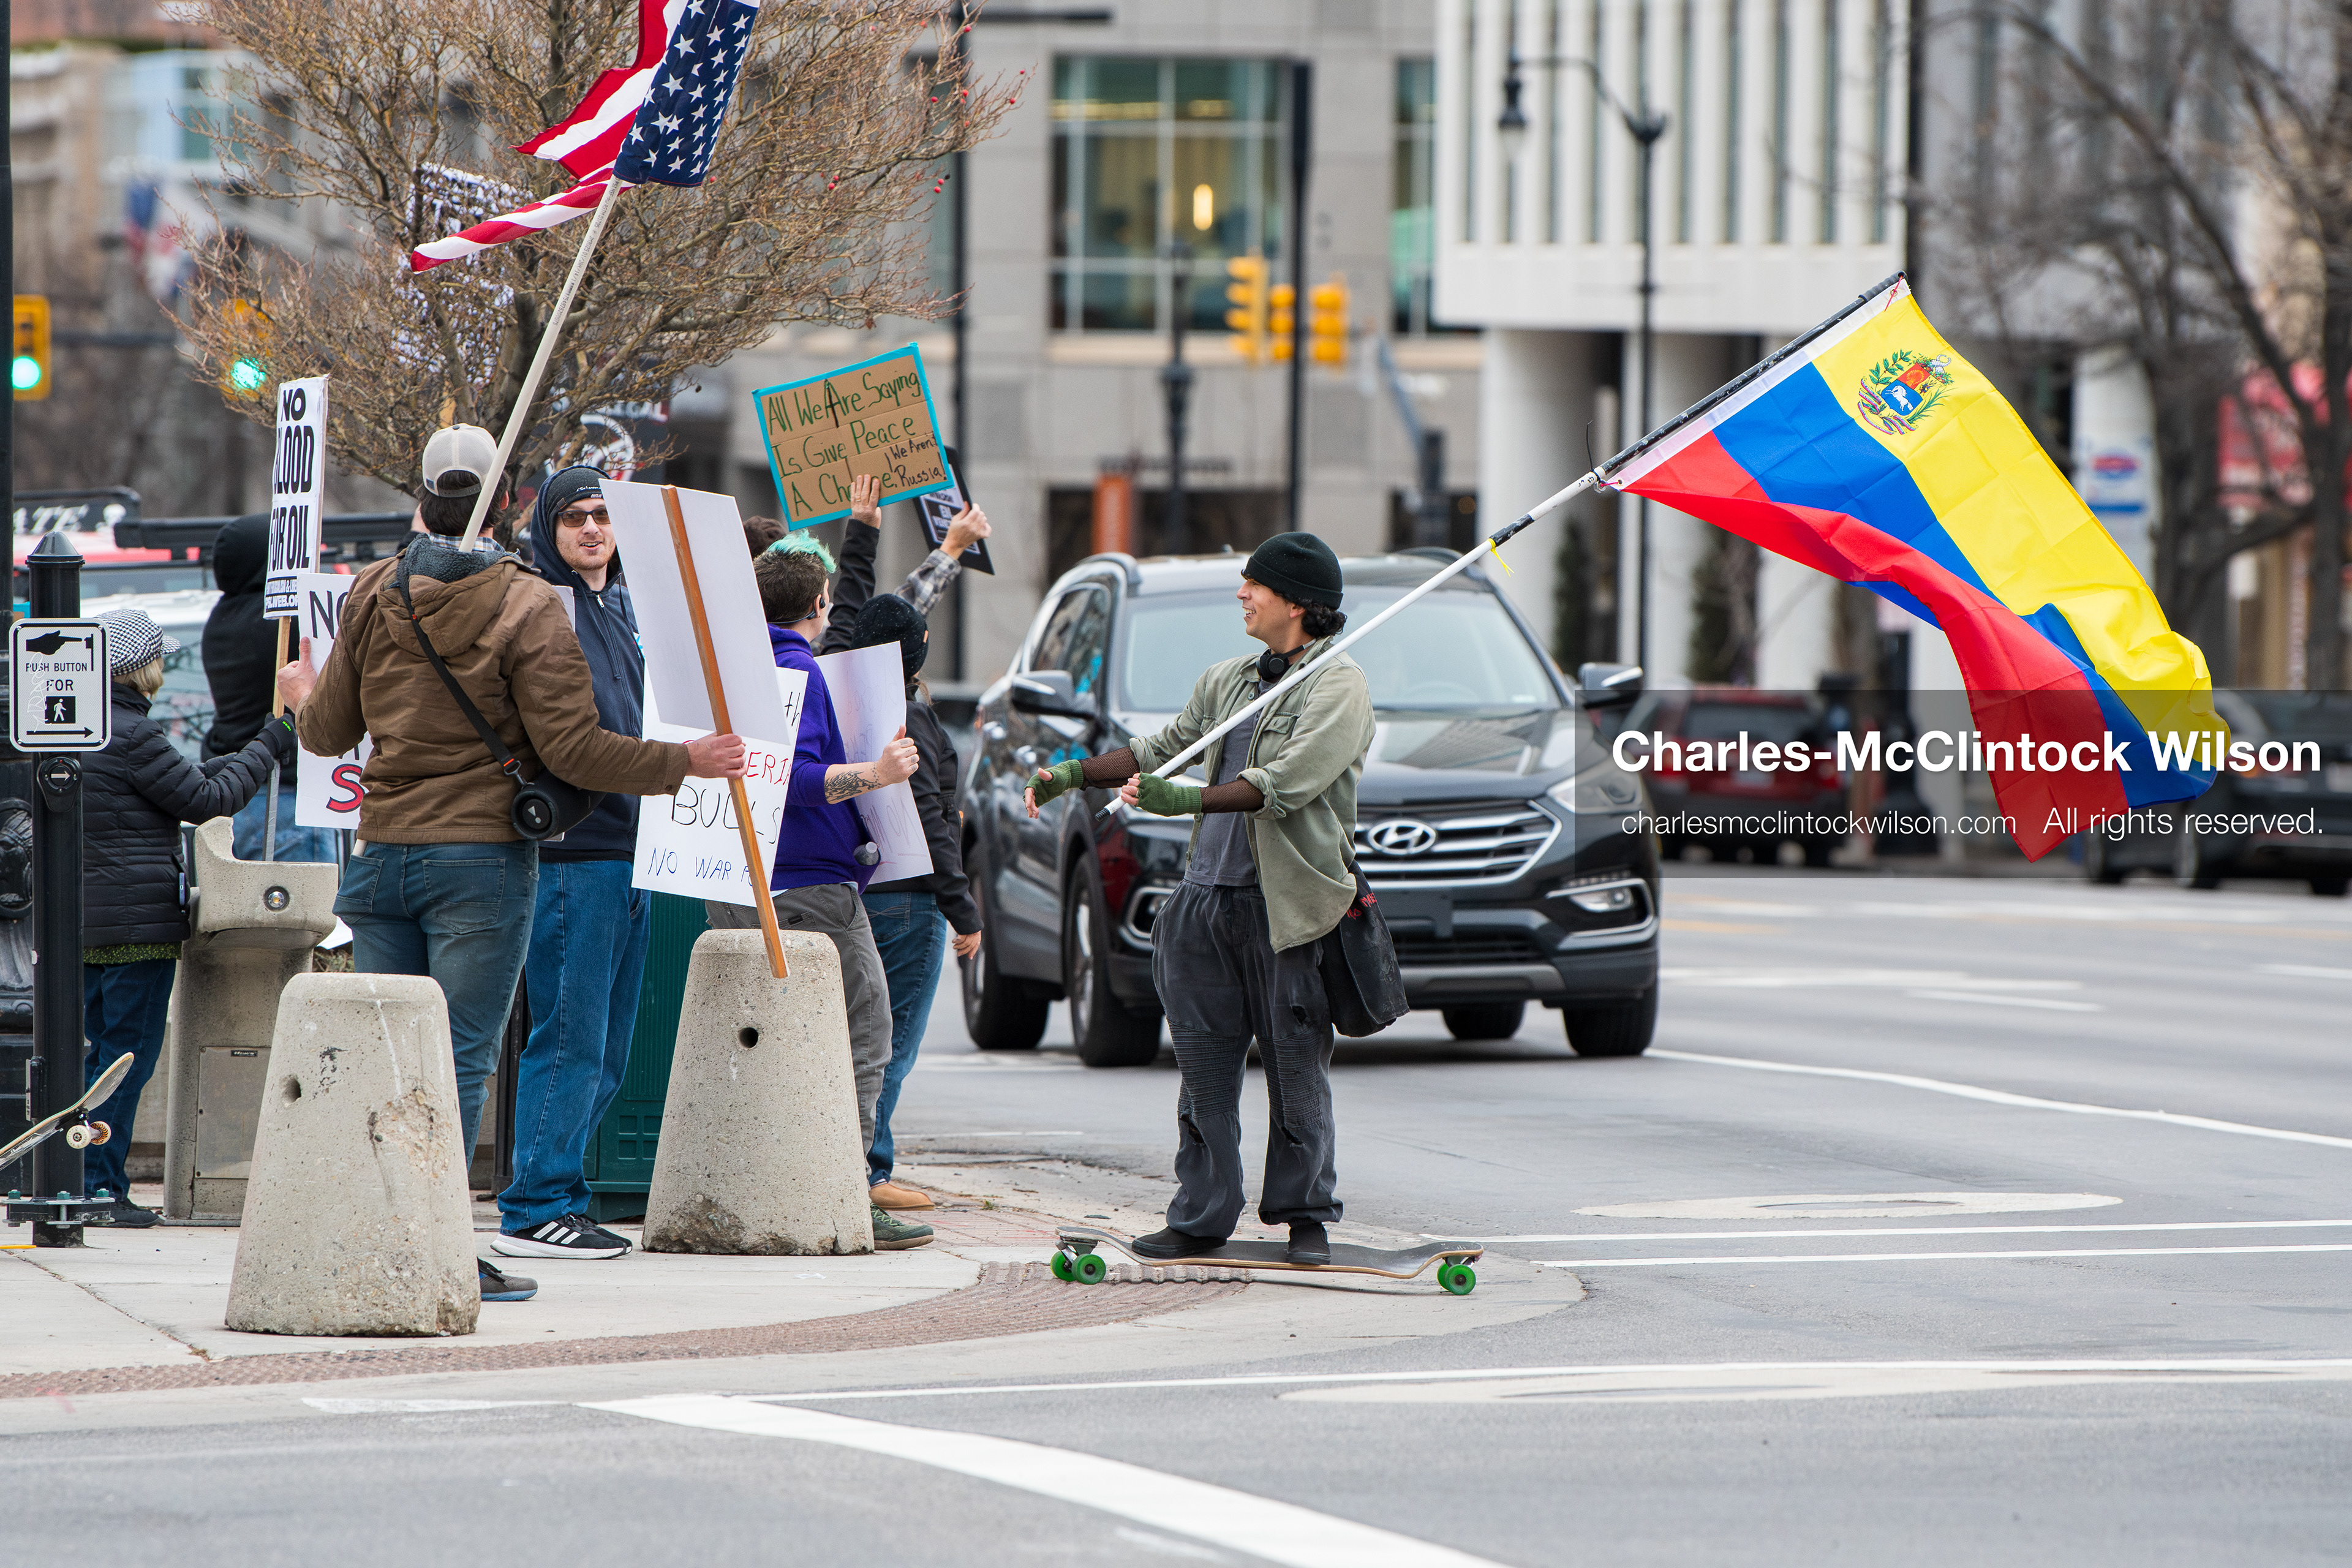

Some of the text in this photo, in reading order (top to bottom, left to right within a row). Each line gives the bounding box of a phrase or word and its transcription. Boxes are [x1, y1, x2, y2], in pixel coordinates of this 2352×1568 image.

[281, 388, 306, 422] NO
[769, 372, 922, 435] All We Are Saying
[274, 425, 315, 495] LOOD
[772, 417, 916, 479] Is Give Peace
[889, 444, 909, 459] We
[791, 481, 813, 517] A
[287, 505, 310, 570] OIL
[26, 662, 88, 673] PUSH BUTTON
[47, 679, 74, 692] FOR
[648, 847, 678, 876] NO
[695, 856, 731, 880] WAR
